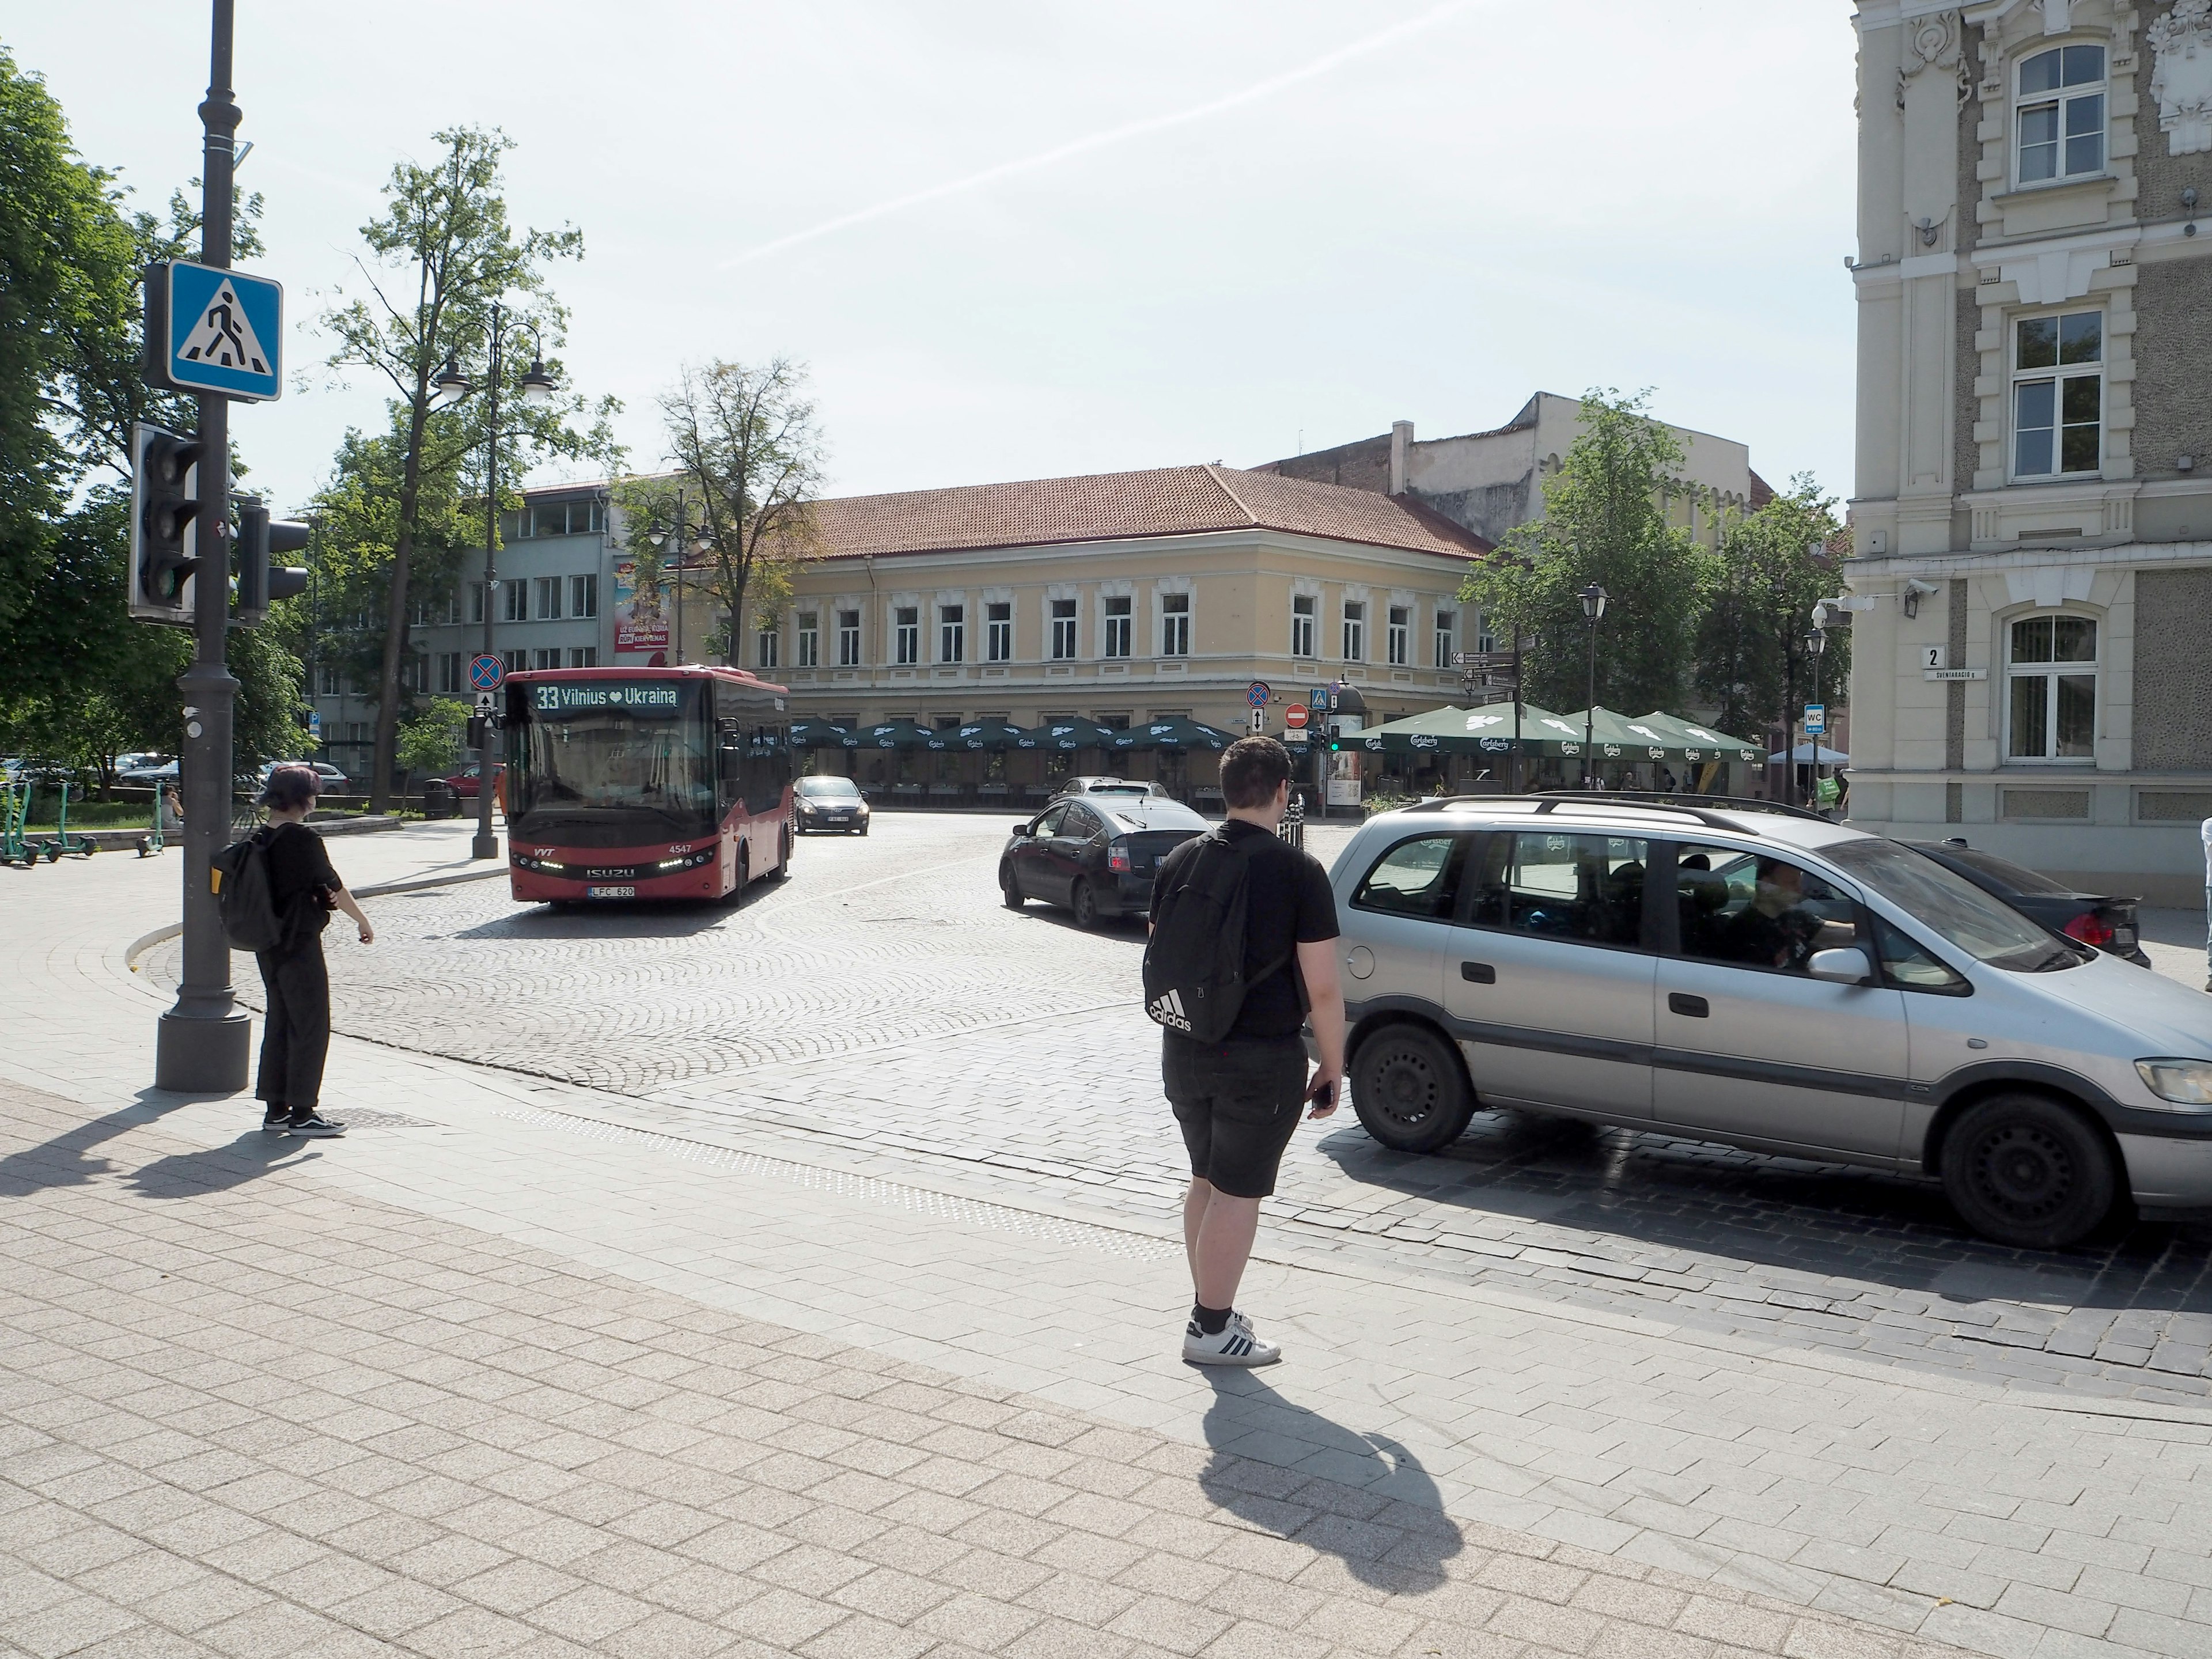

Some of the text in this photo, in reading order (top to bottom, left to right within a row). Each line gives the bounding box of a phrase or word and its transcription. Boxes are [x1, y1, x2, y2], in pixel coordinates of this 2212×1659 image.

[1930, 649, 1937, 665] 2
[537, 686, 677, 709] 33 Vilnius Ukrainą
[312, 714, 318, 724] P
[1410, 734, 1438, 748] Carlsberg
[1479, 737, 1509, 751] Carlsberg
[669, 844, 691, 854] 4547
[1420, 839, 1453, 849] Carlsber
[586, 869, 634, 878] ISUZU
[617, 888, 633, 896] 620
[1149, 1005, 1192, 1032] adidas
